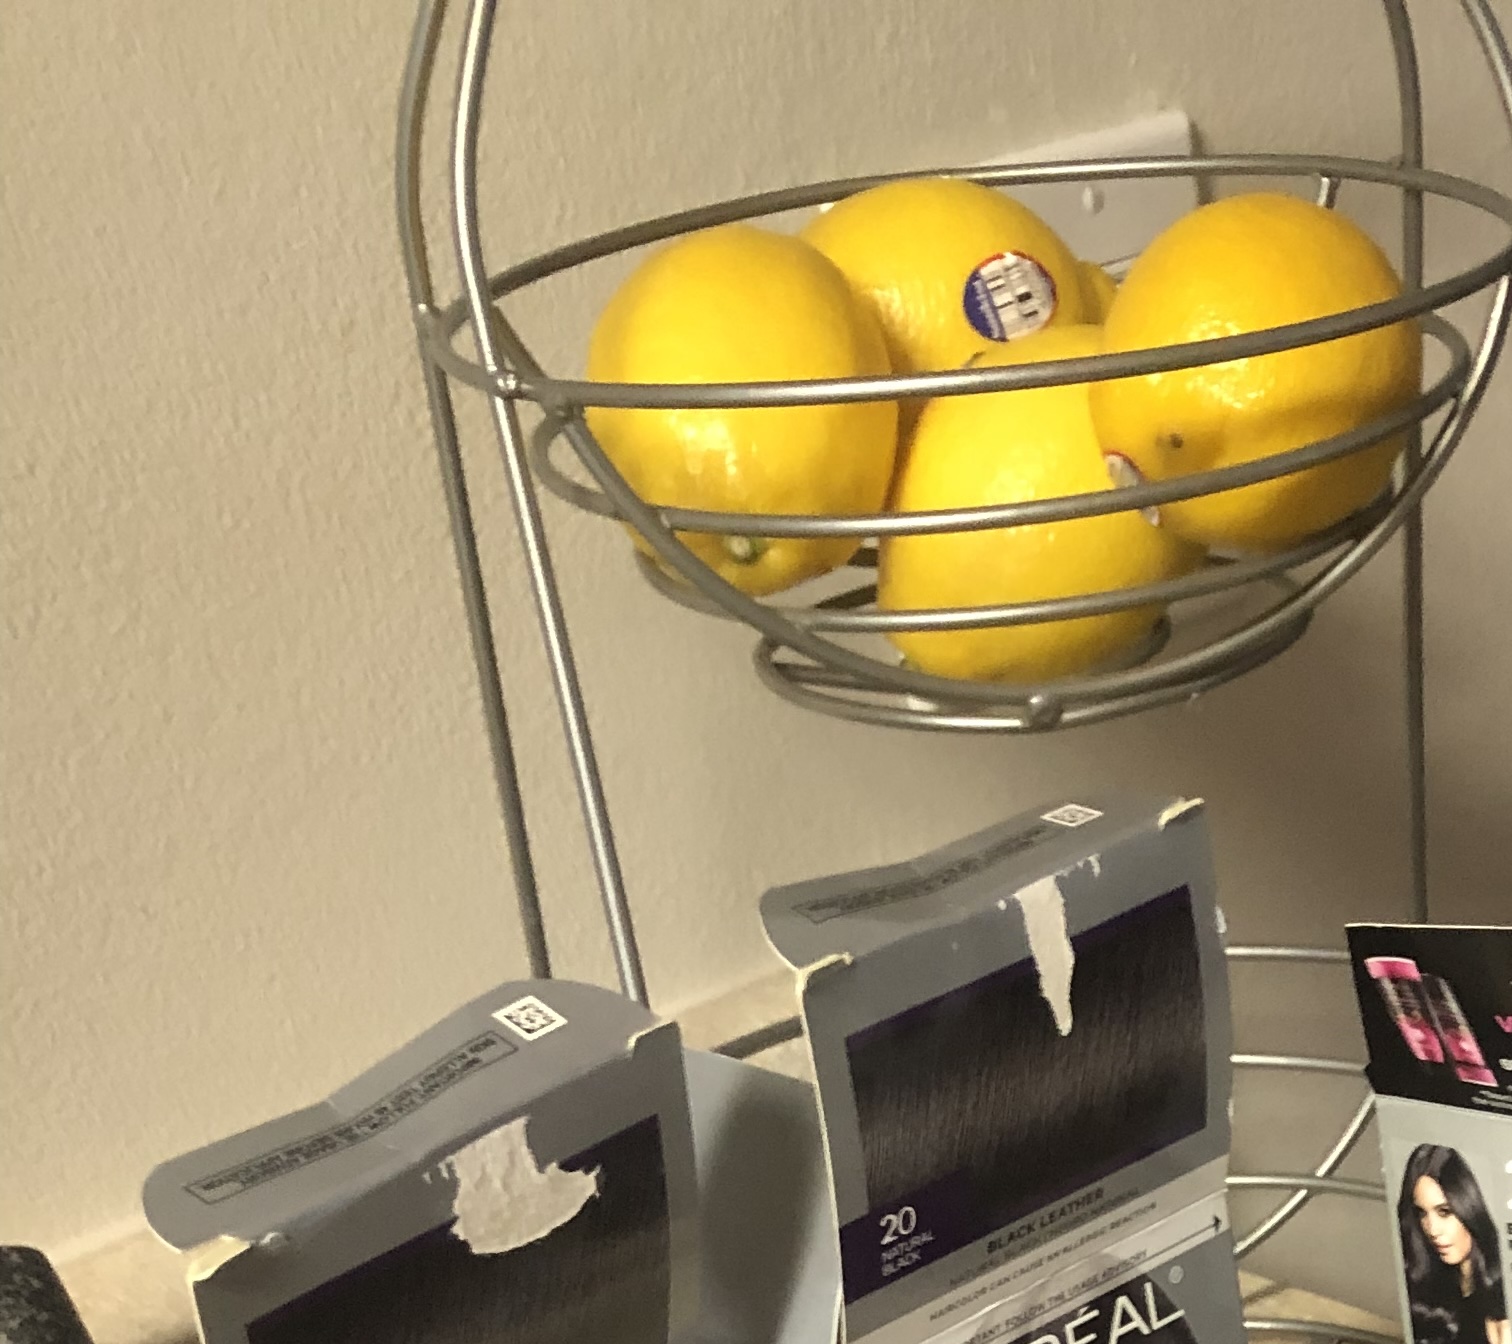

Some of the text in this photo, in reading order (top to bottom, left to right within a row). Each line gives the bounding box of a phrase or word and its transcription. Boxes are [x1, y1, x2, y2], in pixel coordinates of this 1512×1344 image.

[879, 1205, 917, 1246] 20
[986, 1186, 1105, 1254] BLACK LEATHER
